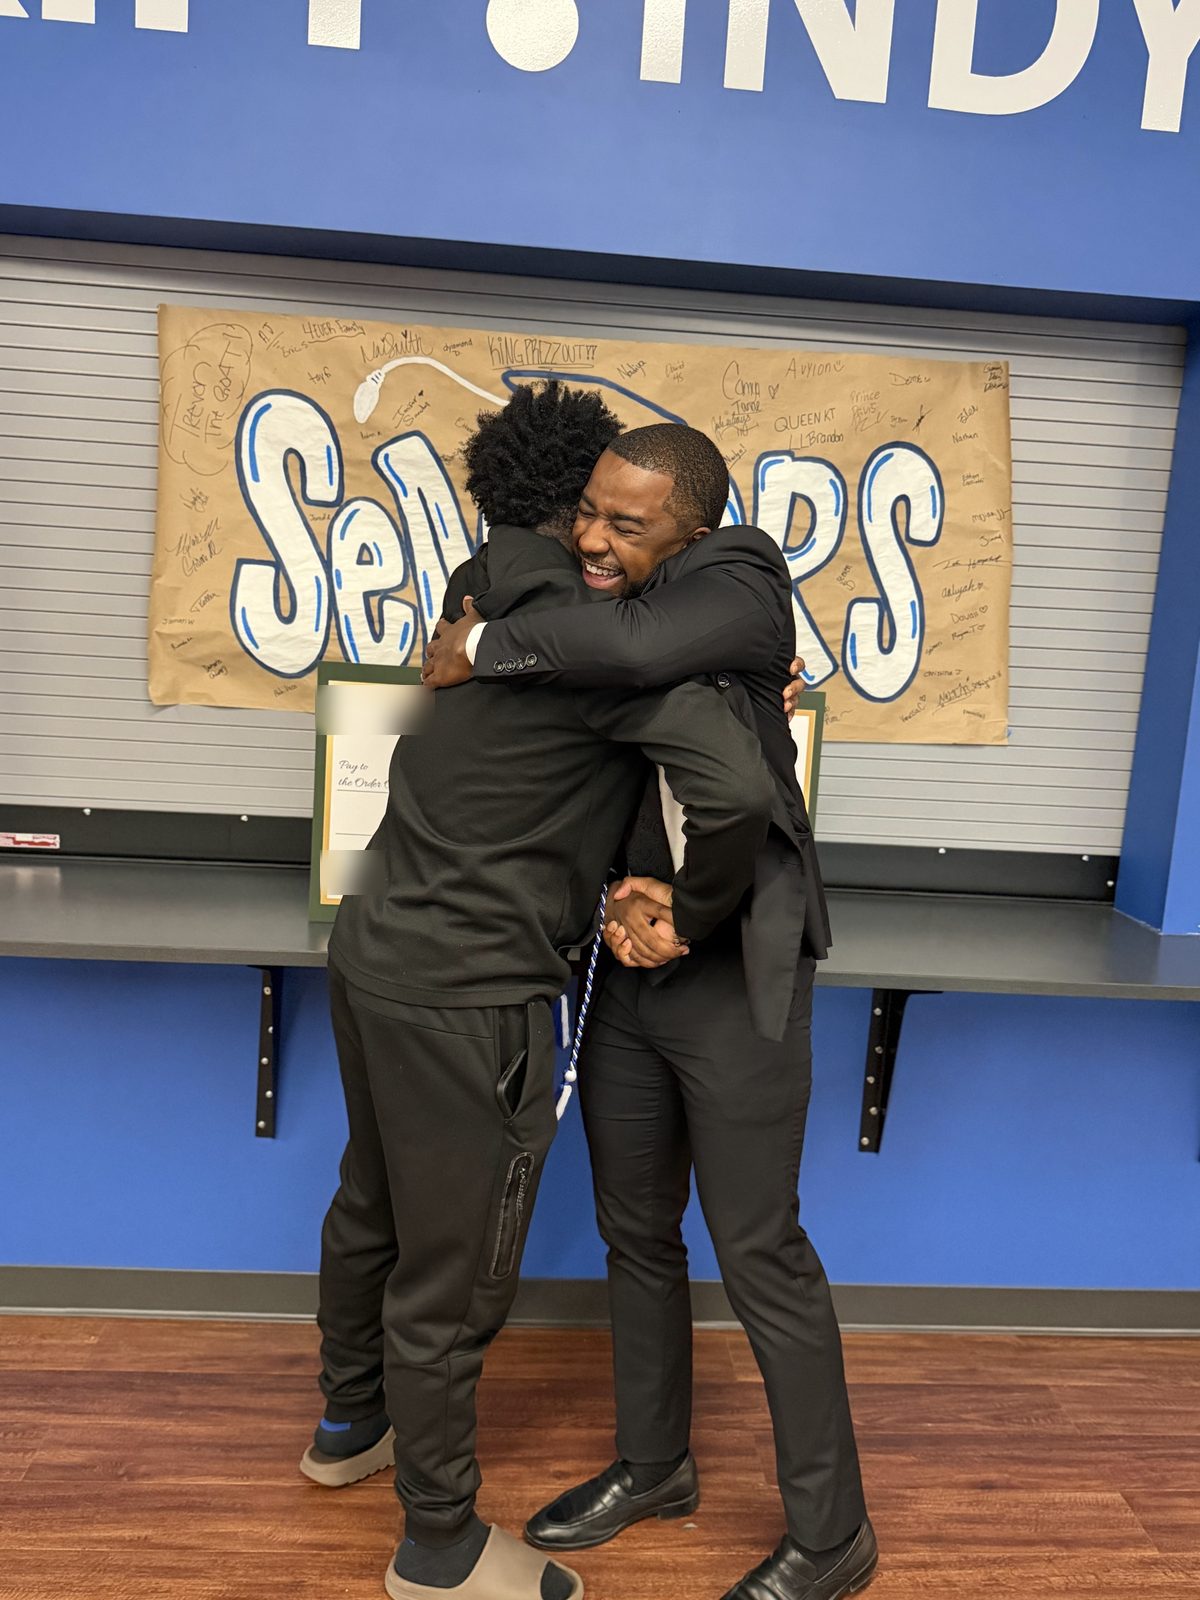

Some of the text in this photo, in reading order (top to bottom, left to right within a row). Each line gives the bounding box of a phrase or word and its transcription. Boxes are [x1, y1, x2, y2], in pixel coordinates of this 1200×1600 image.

[774, 410, 821, 433] QUEEN
[824, 408, 836, 423] KT
[339, 760, 358, 774] Pay
[338, 777, 353, 786] the
[355, 777, 382, 789] Order
